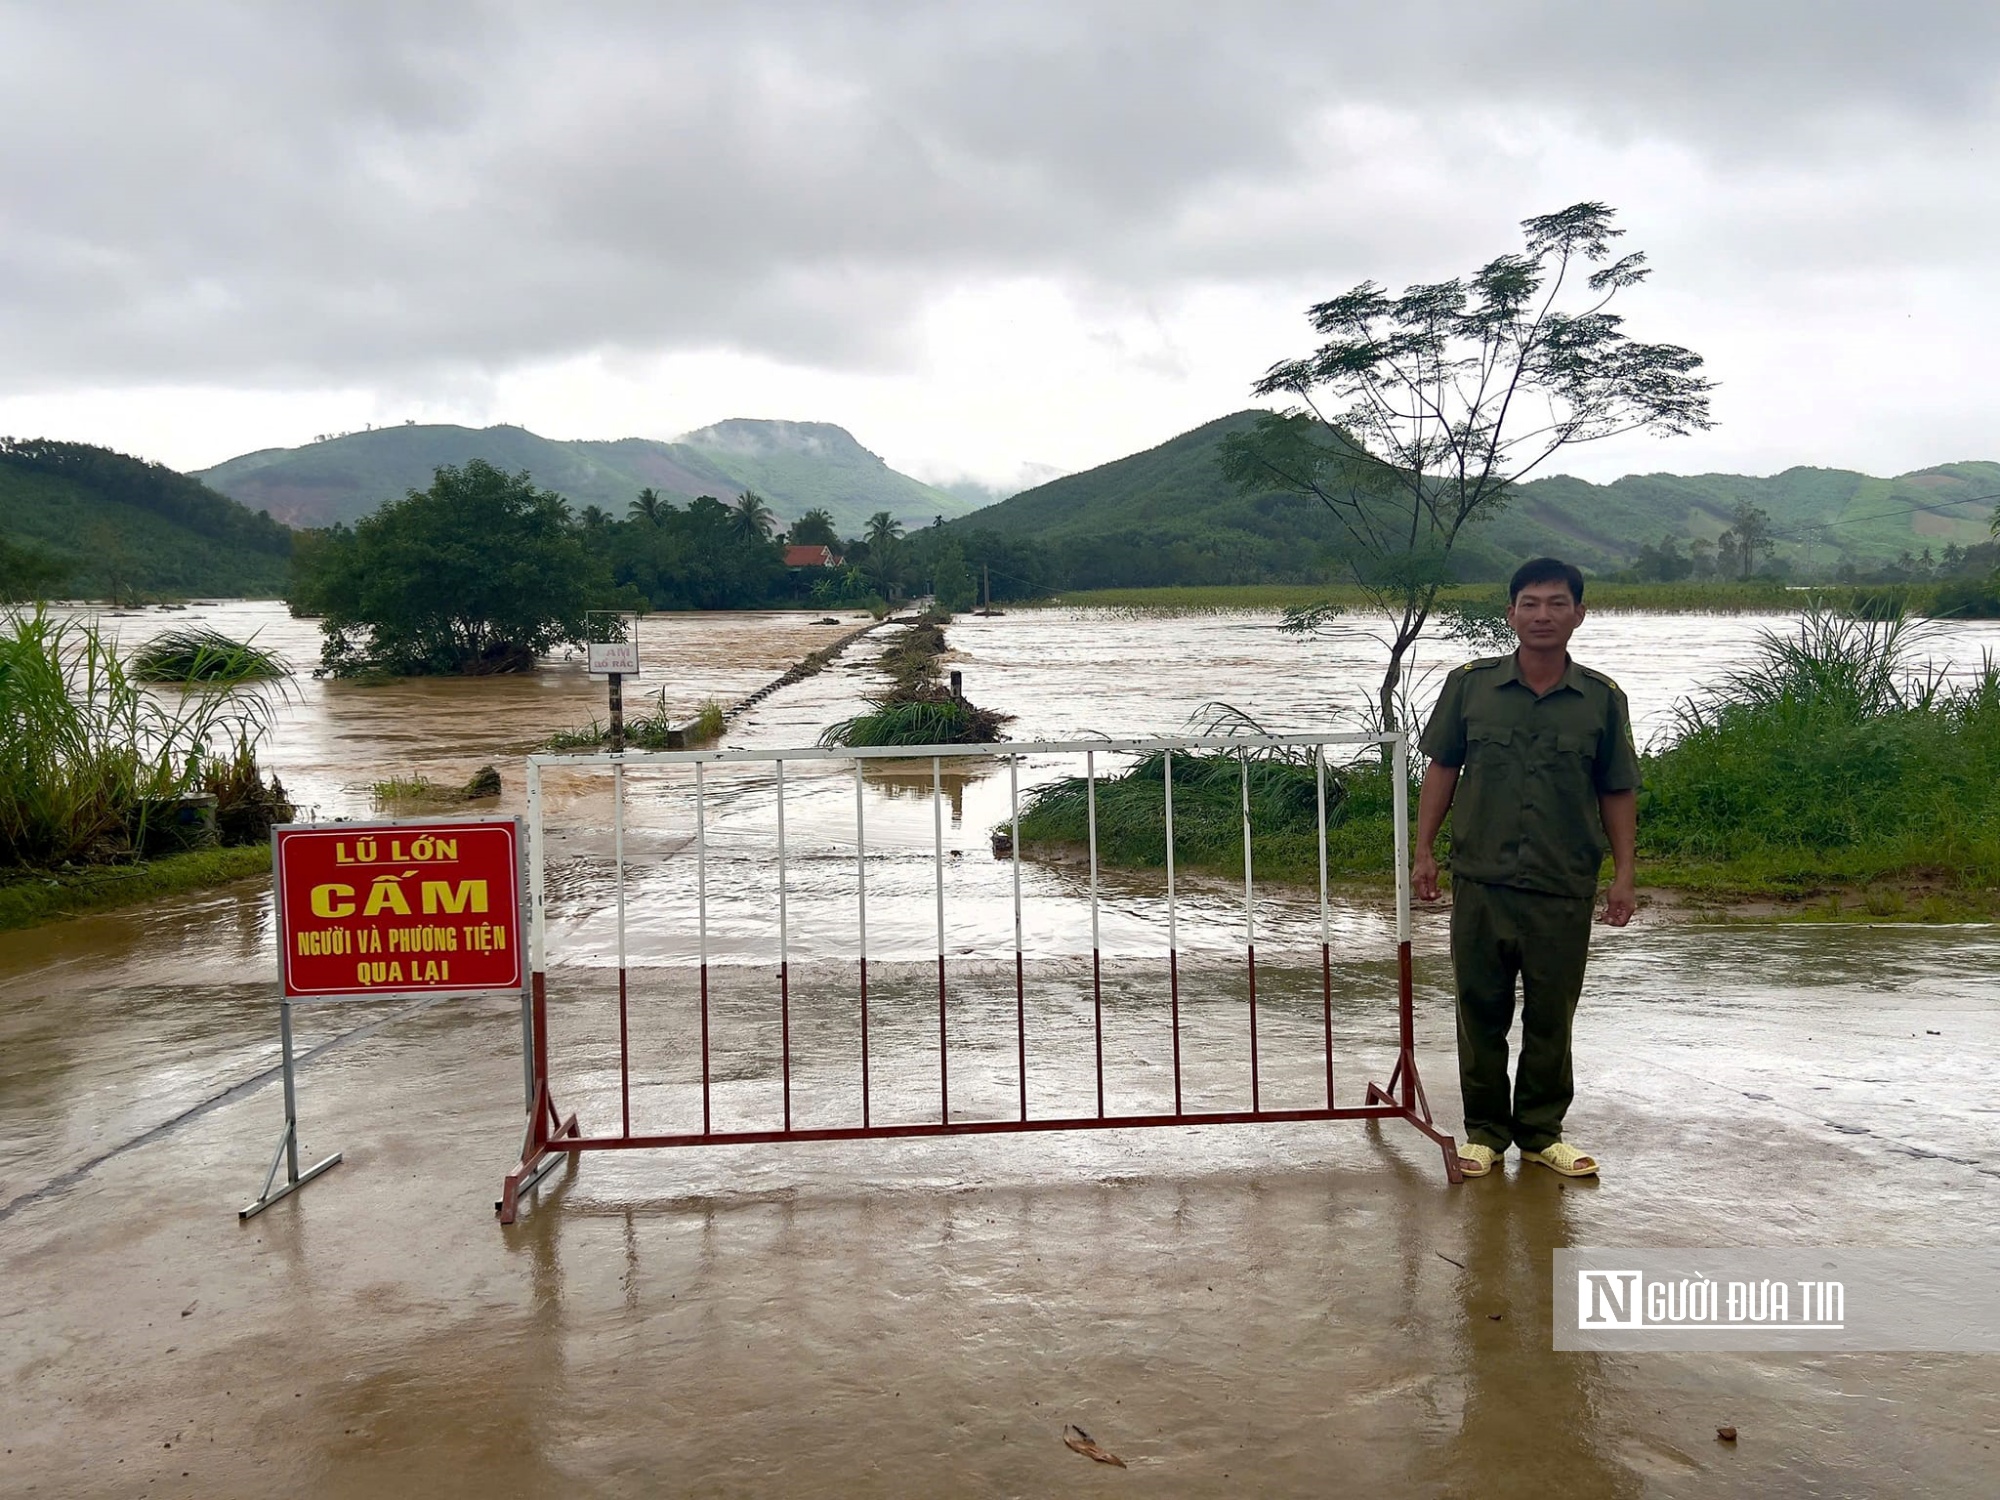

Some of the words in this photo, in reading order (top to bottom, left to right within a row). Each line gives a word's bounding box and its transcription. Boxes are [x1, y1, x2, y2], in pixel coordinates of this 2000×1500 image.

[336, 836, 377, 863] LŨ
[392, 834, 458, 861] LỚN
[310, 870, 489, 918] CẤM
[297, 926, 351, 956] NGƯỜI
[357, 924, 382, 954] VÀ
[389, 924, 457, 953] PHƯƠNG
[463, 922, 506, 956] TIỆN
[357, 961, 404, 986] QUA
[411, 960, 449, 985] LẠI
